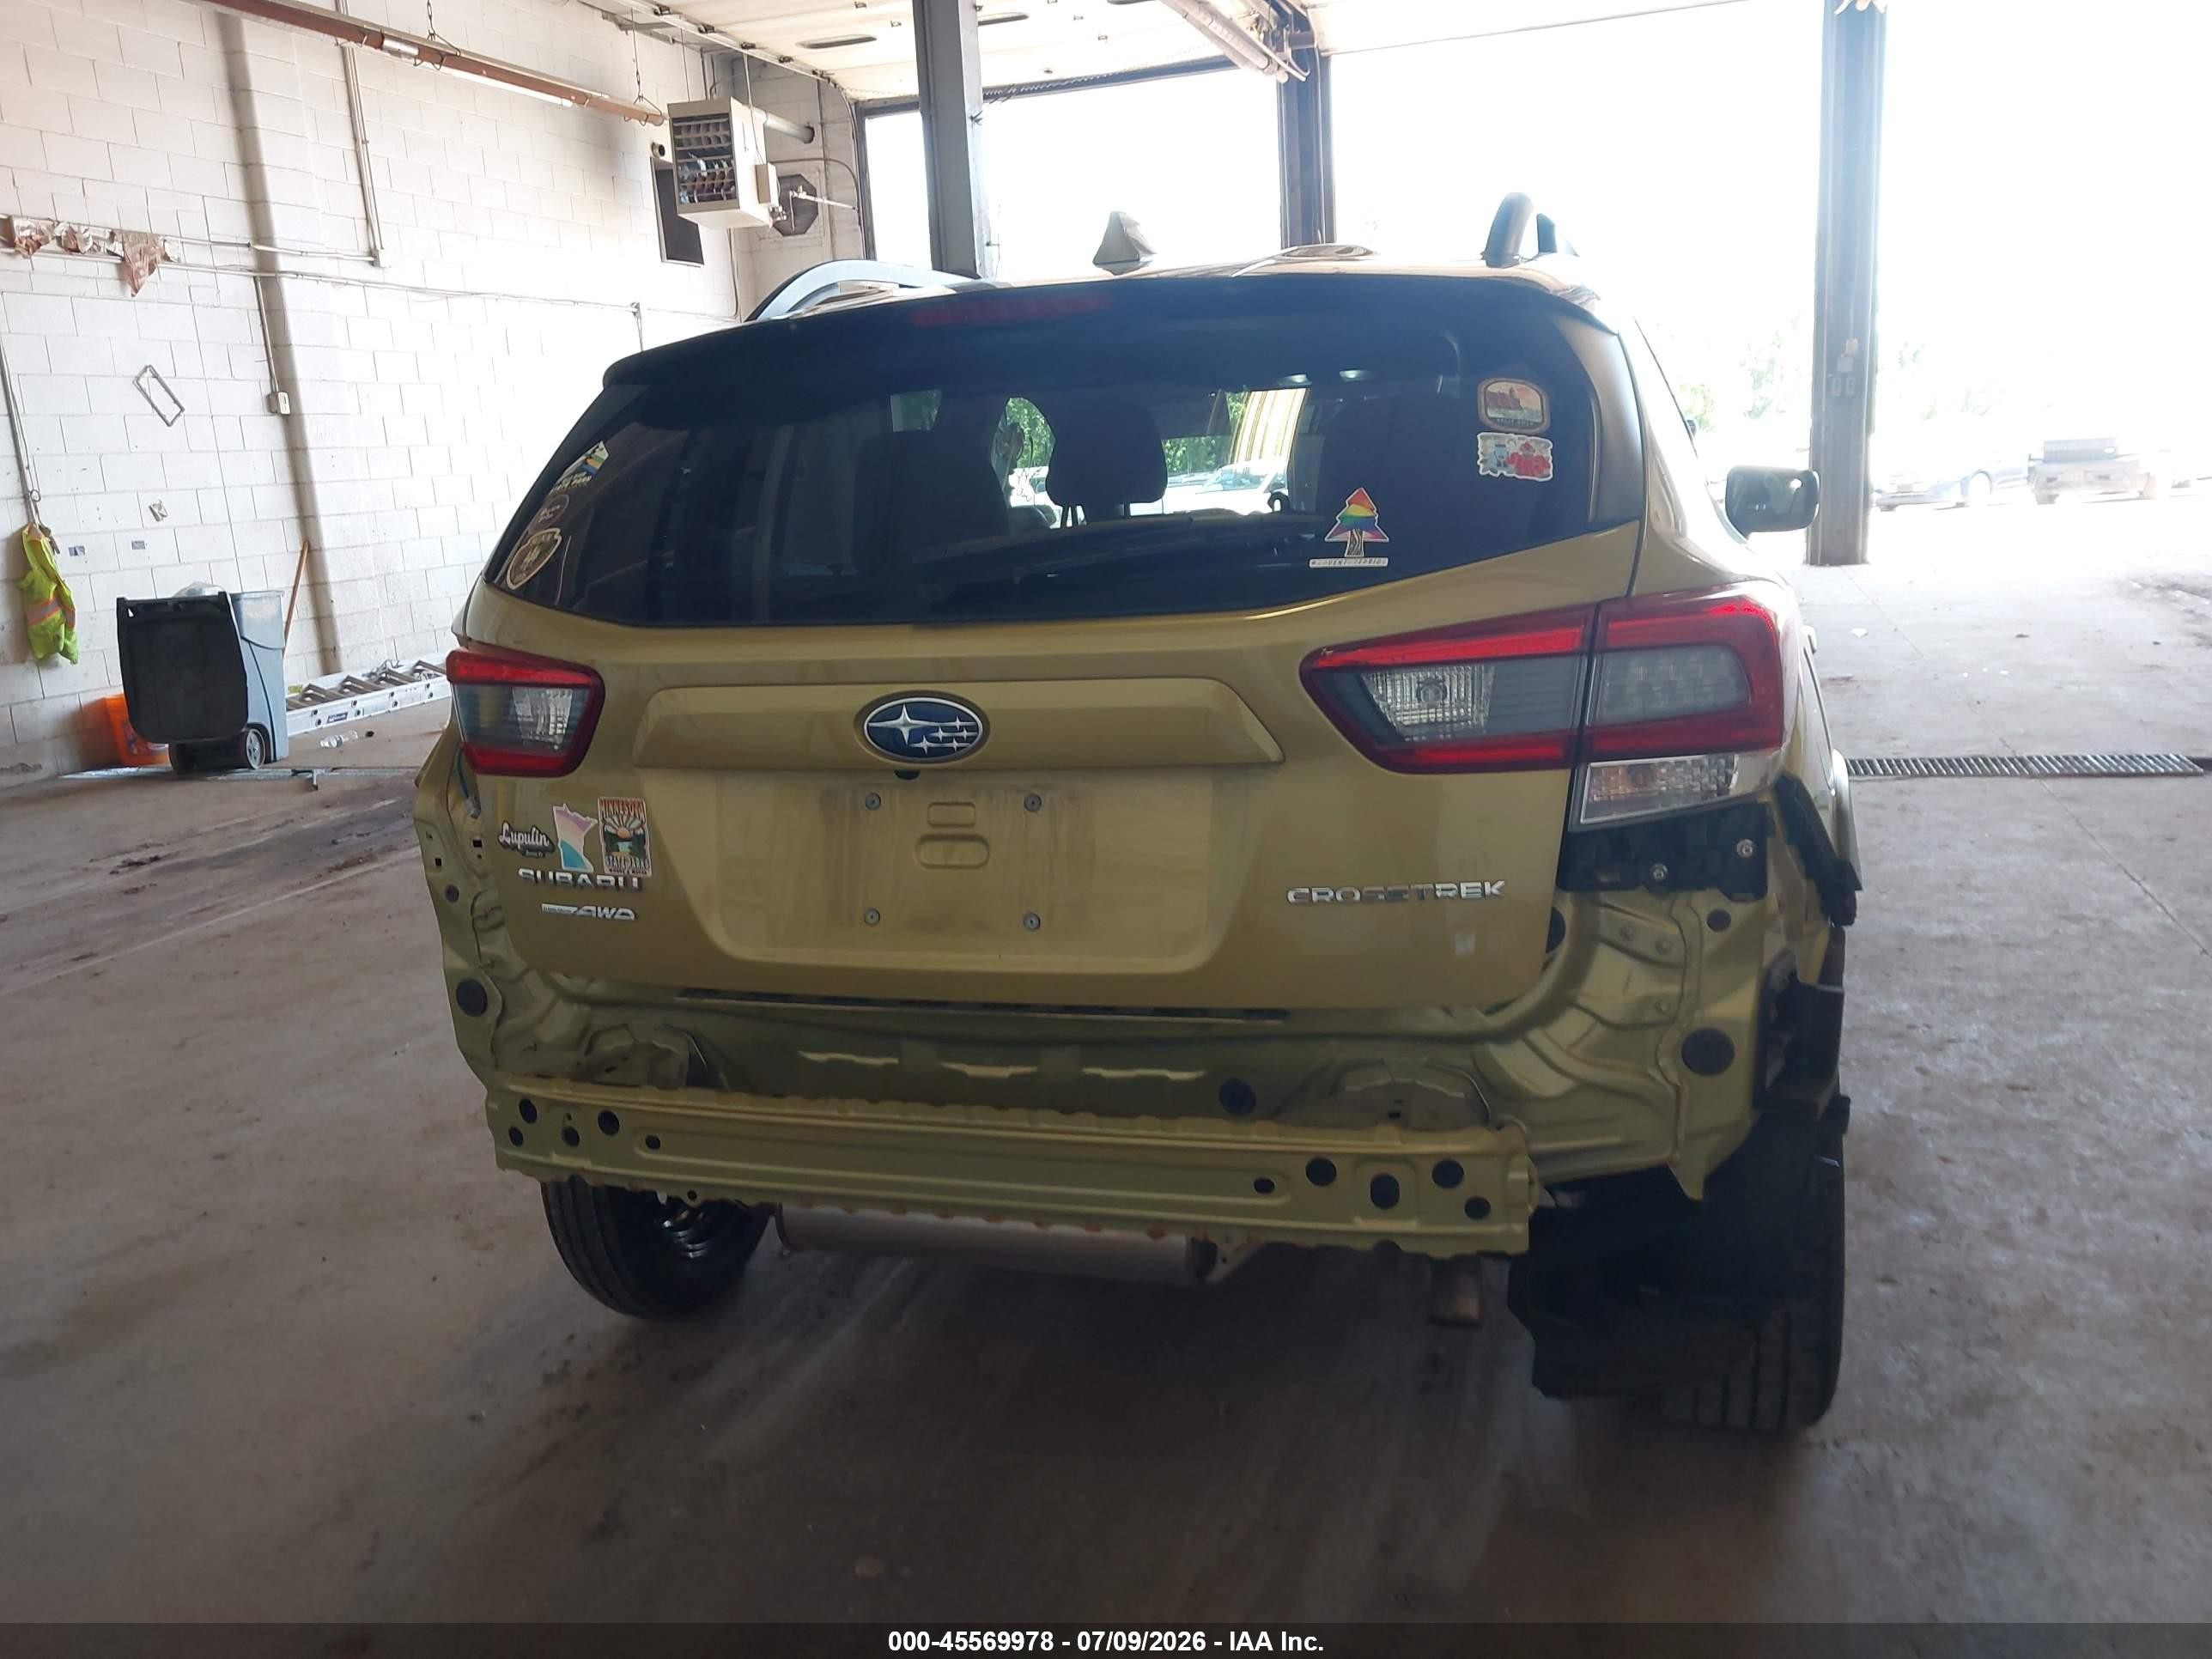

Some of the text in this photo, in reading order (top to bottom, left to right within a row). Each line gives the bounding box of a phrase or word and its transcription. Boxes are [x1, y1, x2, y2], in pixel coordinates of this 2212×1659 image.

[498, 822, 550, 850] Lupulin
[518, 868, 641, 890] SUBARU
[1287, 880, 1505, 903] CROSSTREK
[576, 905, 635, 921] AWD
